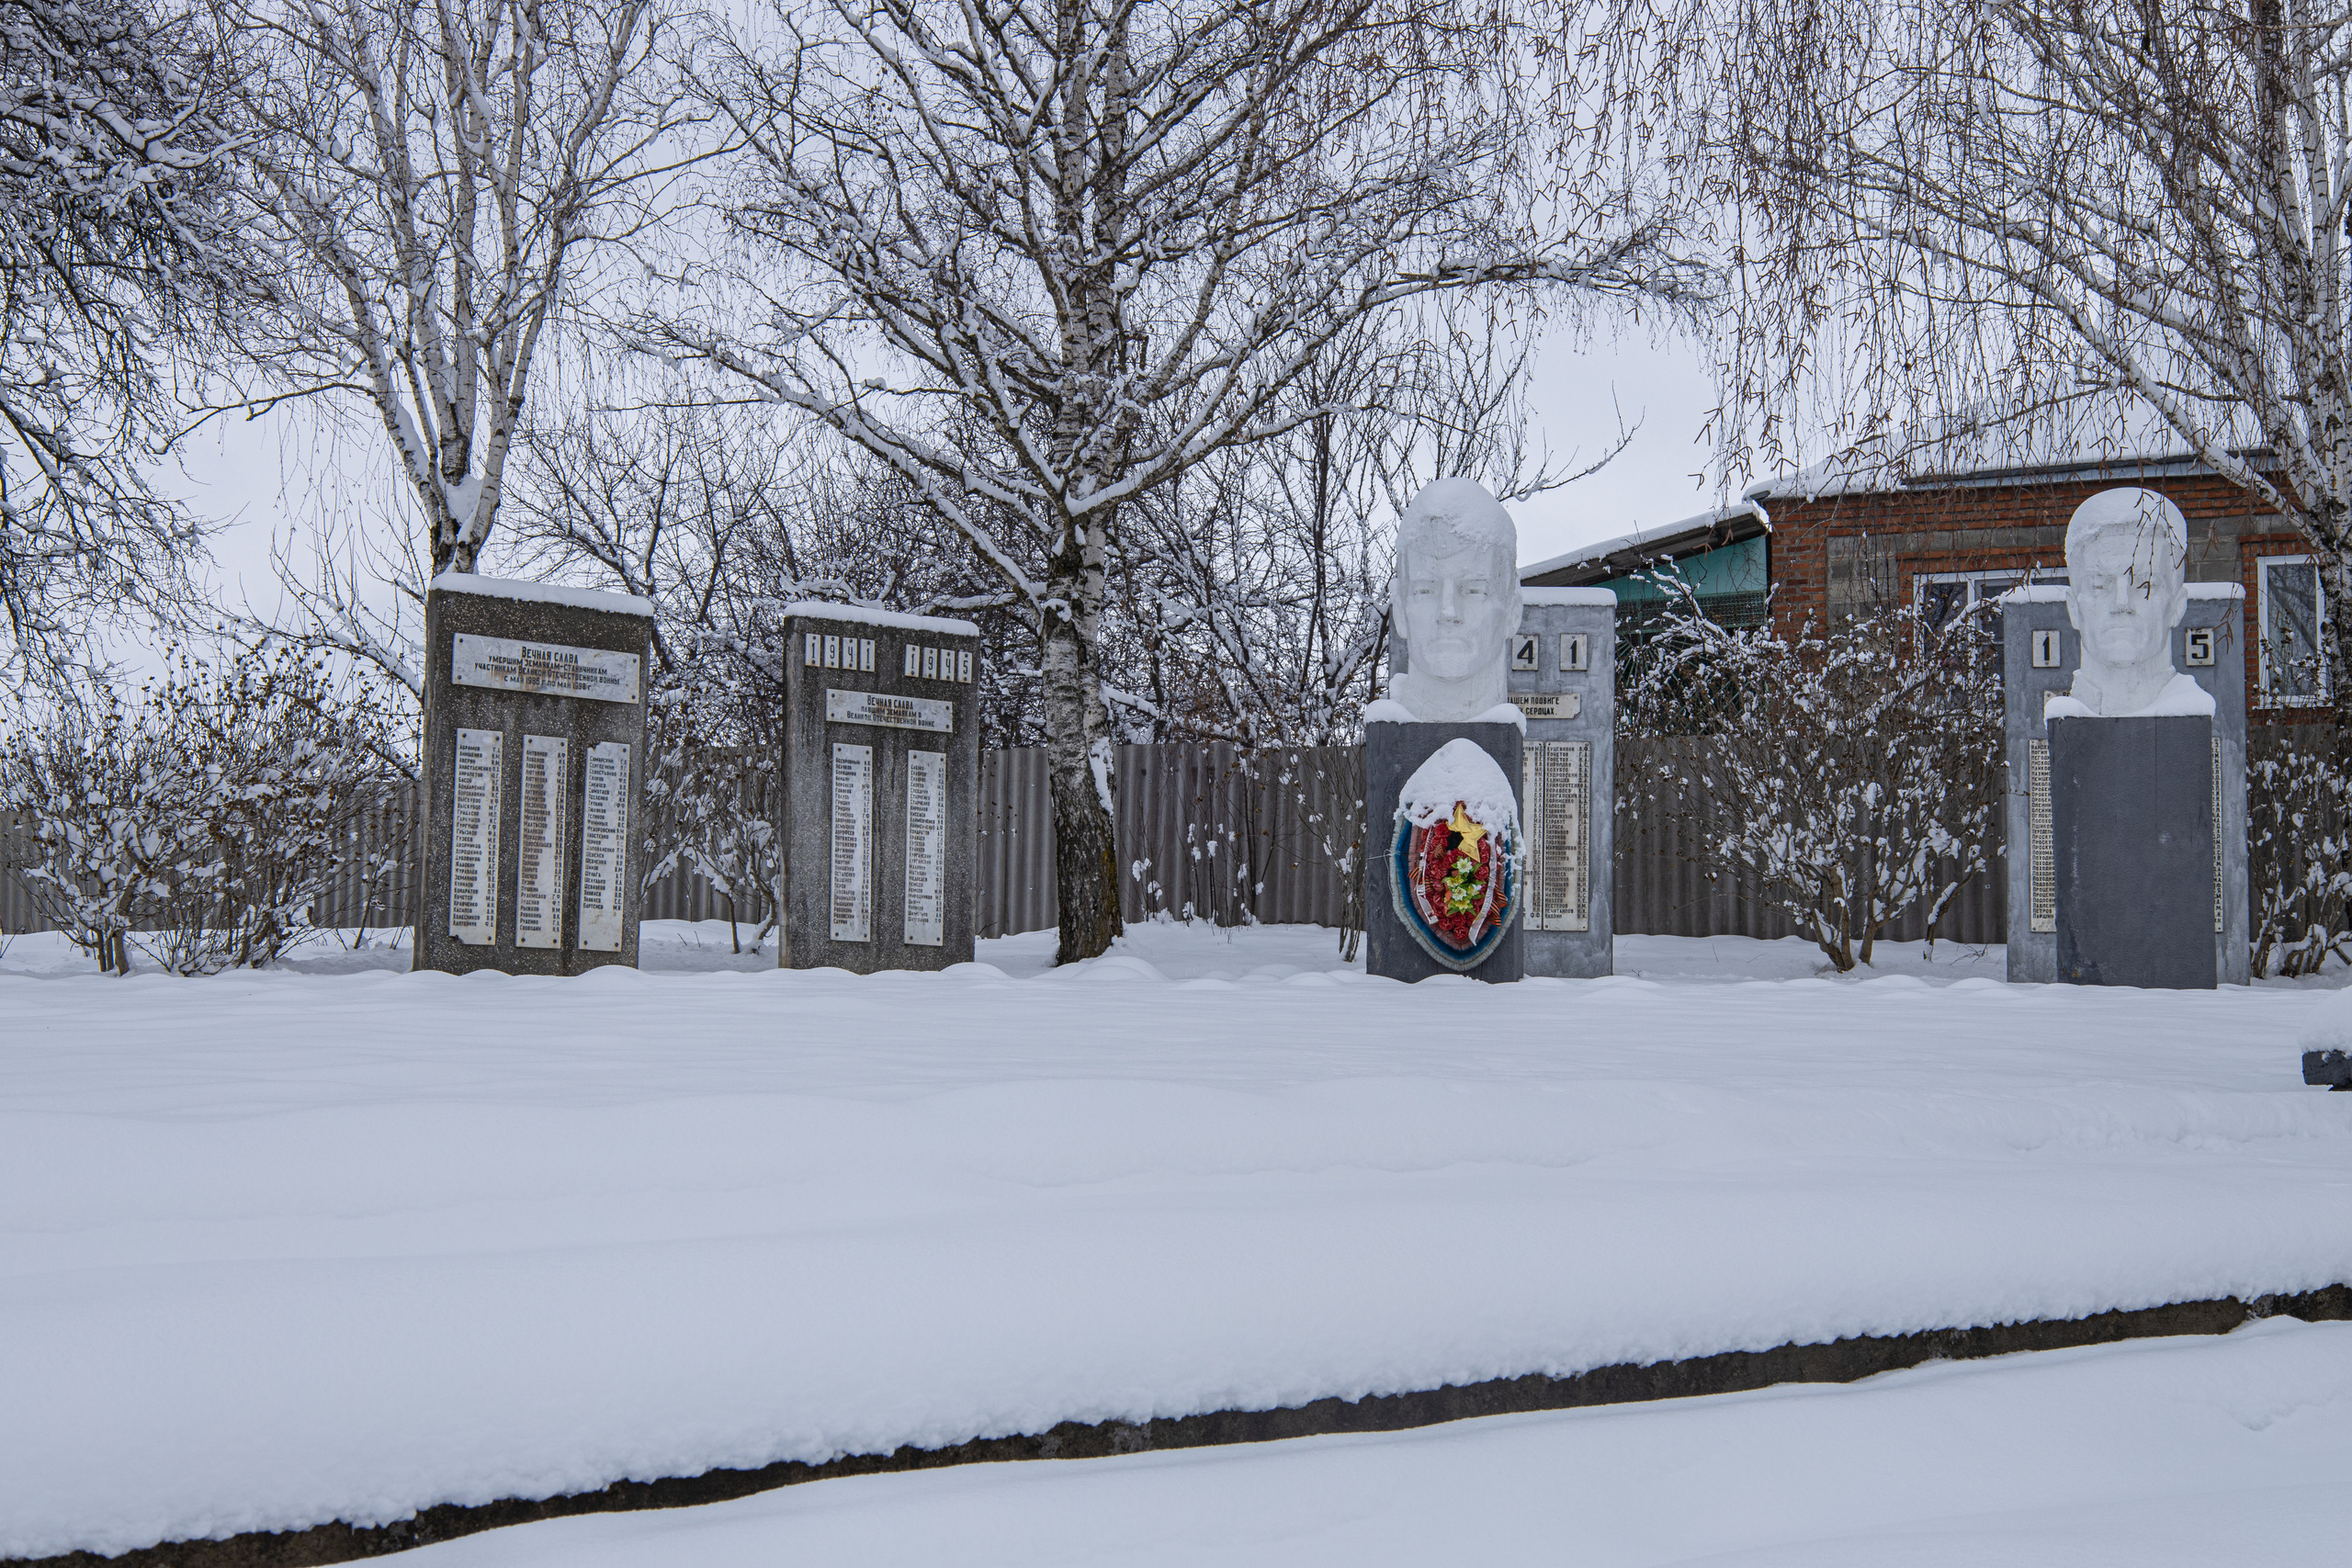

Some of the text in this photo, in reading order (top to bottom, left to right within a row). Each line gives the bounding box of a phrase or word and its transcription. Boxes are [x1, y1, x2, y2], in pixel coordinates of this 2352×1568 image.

[1517, 640, 1577, 664] 4 1
[2042, 634, 2210, 660] 1 5
[1531, 696, 1559, 705] ПОДВИГЕ
